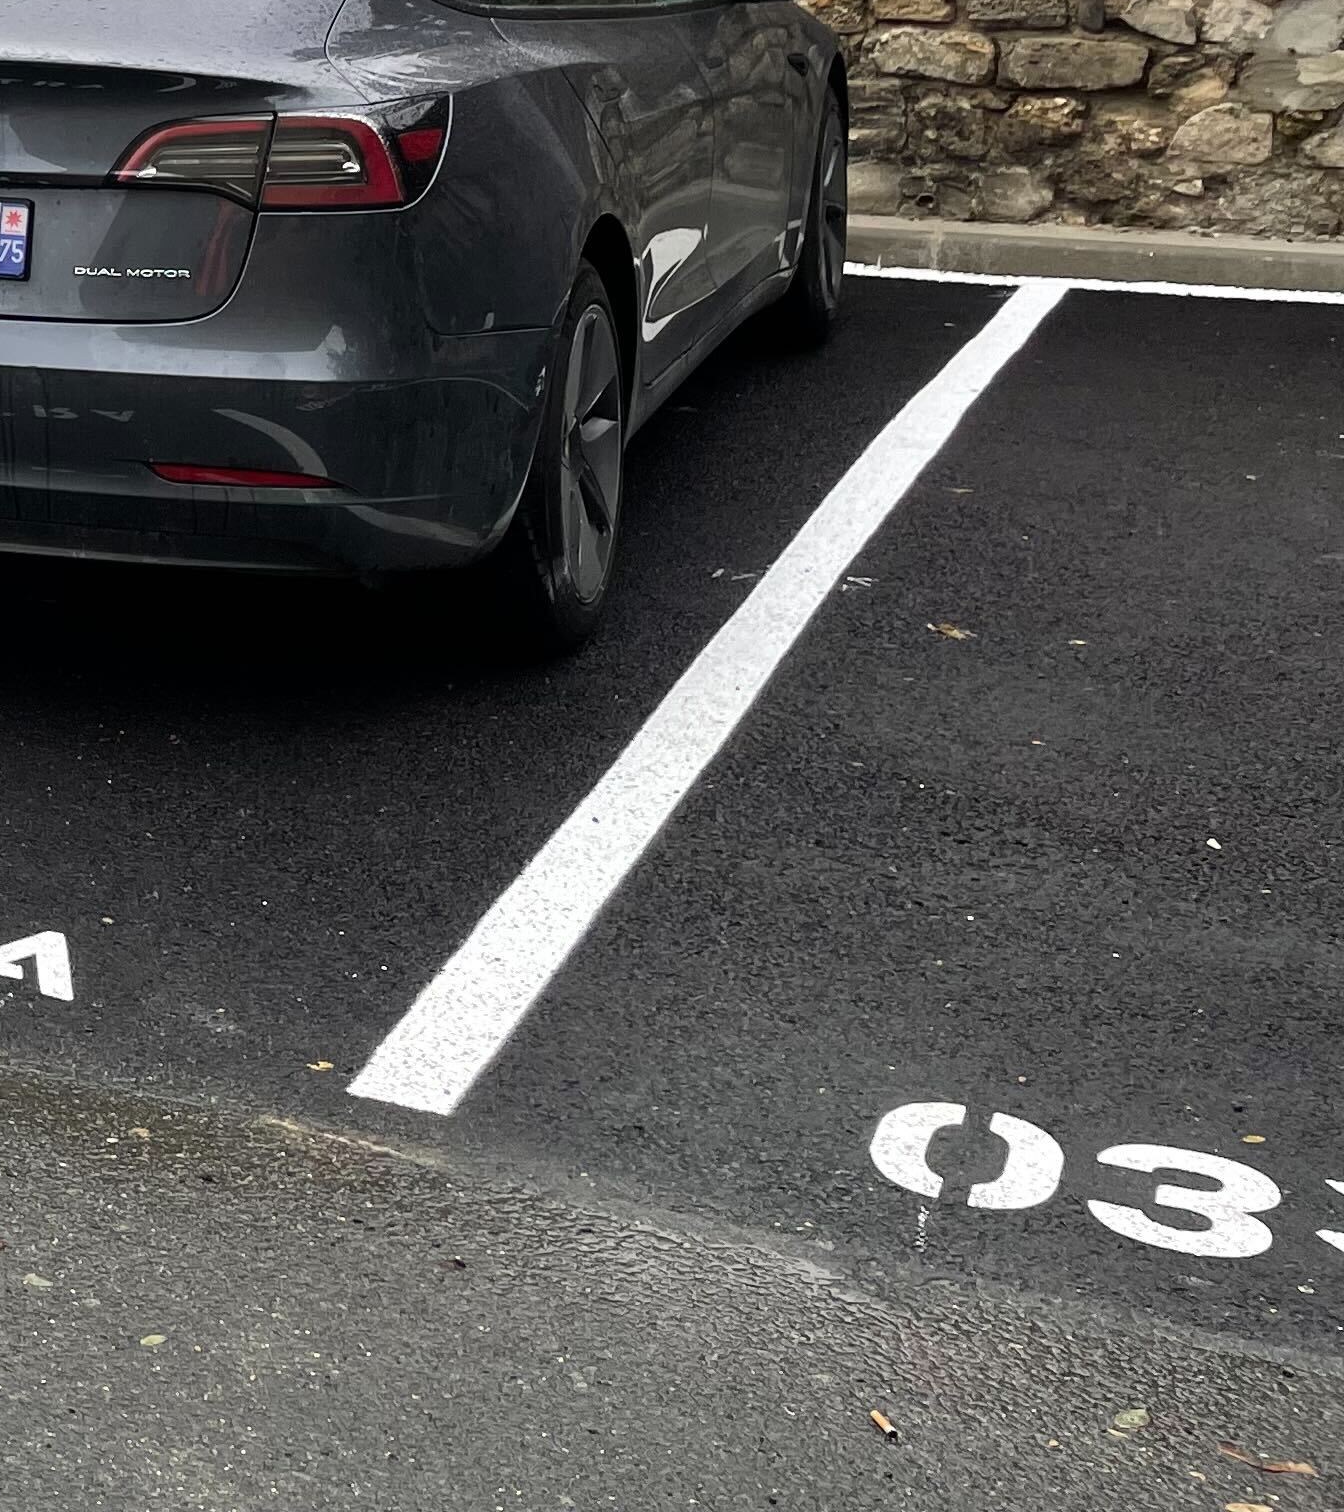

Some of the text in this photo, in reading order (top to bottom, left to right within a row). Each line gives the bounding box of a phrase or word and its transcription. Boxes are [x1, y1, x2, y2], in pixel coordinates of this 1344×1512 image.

[74, 267, 191, 278] DUAL MOTOR
[868, 1101, 1282, 1259] 03
